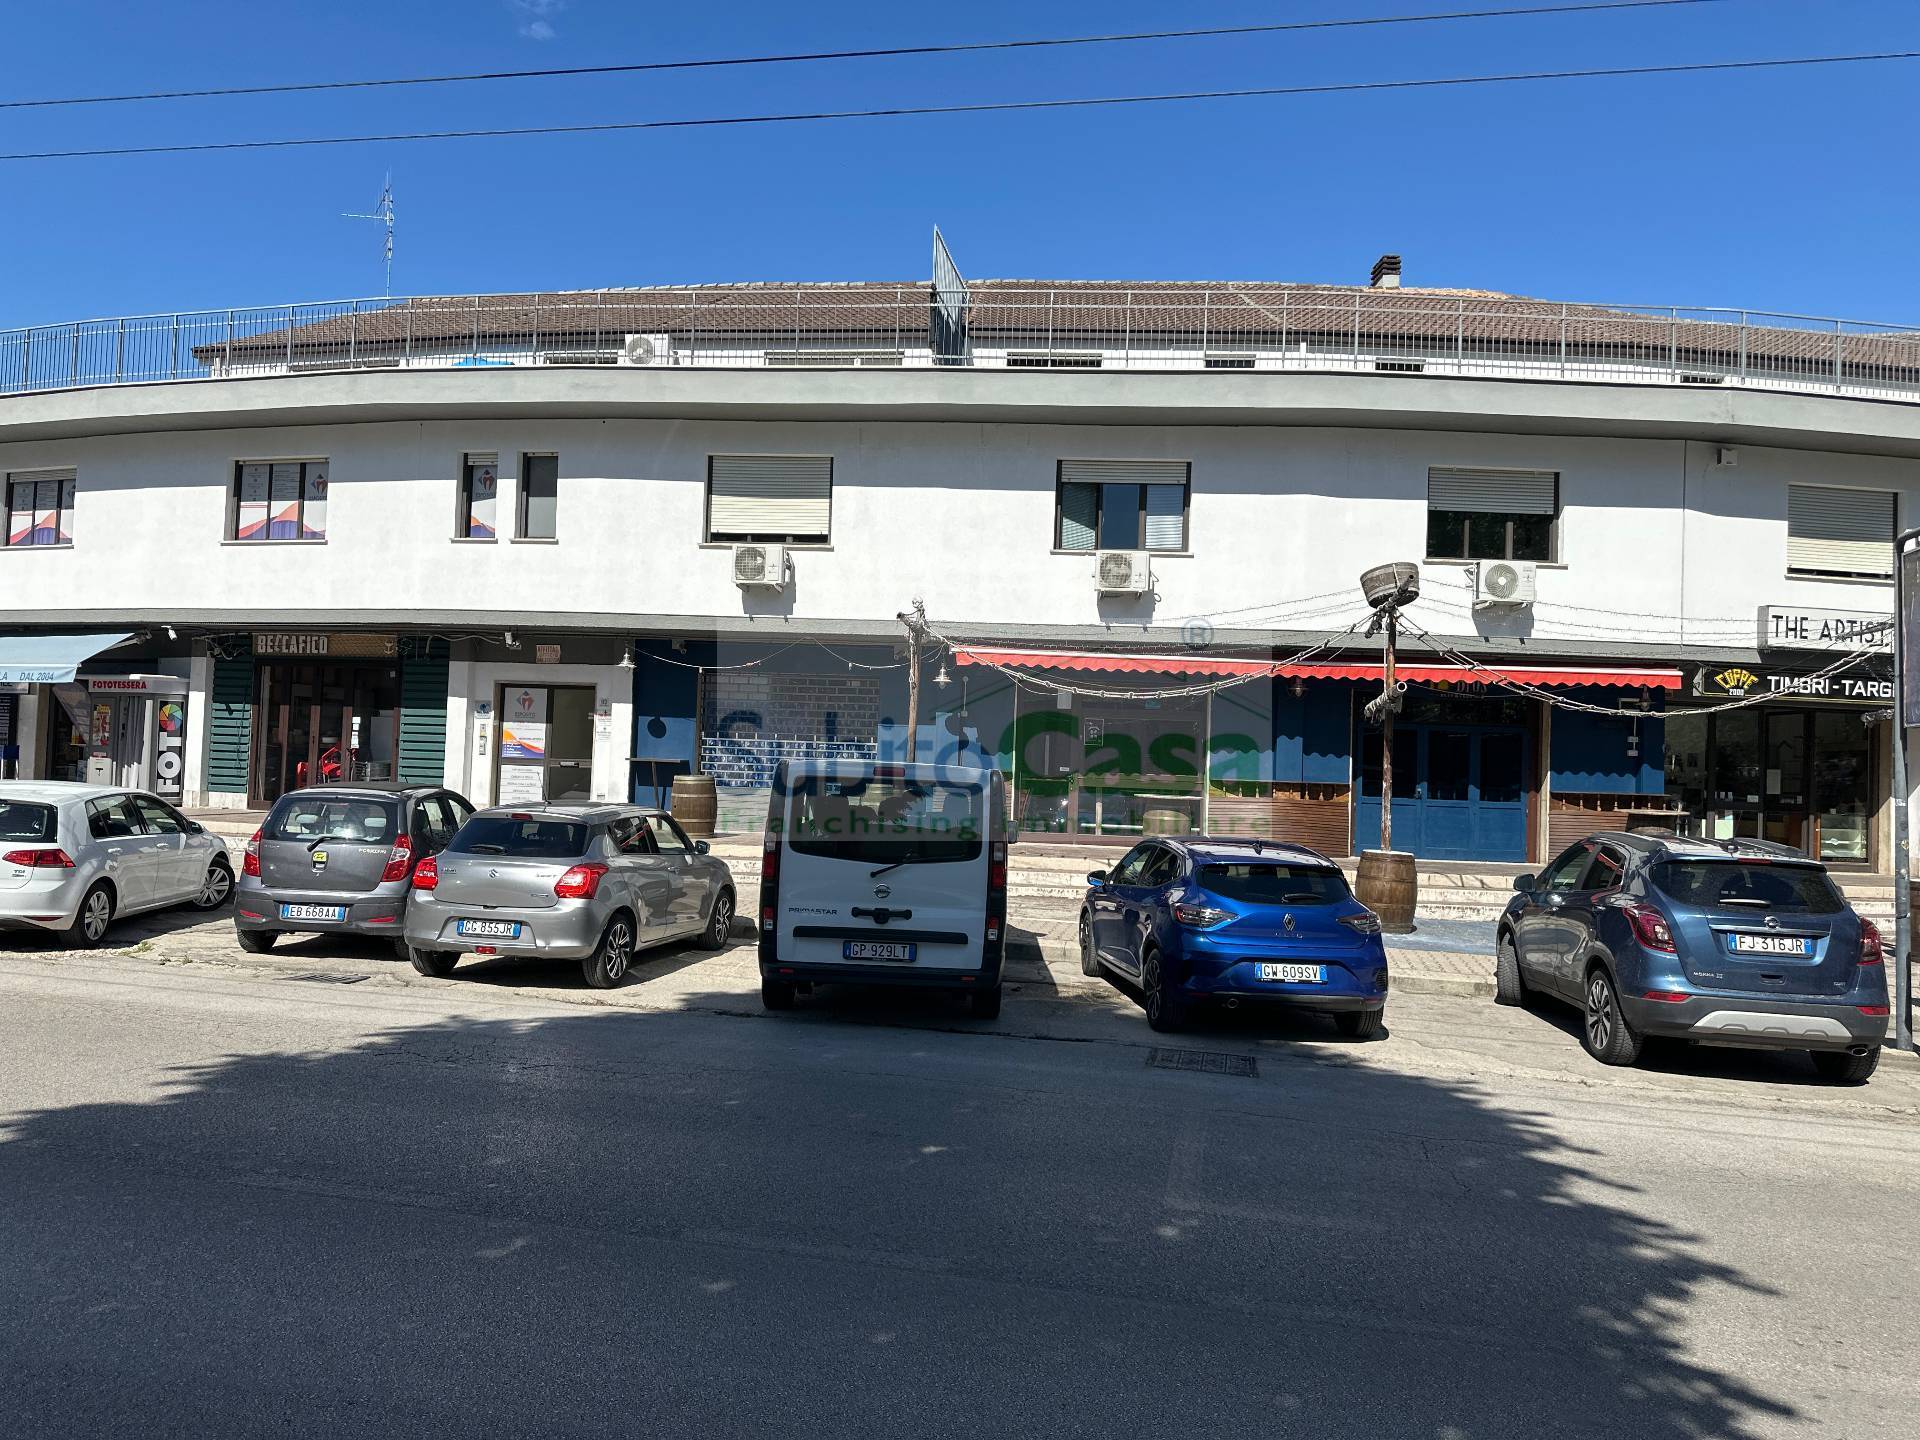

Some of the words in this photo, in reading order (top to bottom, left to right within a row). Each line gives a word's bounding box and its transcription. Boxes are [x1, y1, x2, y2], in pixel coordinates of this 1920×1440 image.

[1771, 614, 1809, 640] THE
[256, 634, 329, 654] BECCAFICO
[19, 672, 35, 681] DAL
[36, 672, 55, 681] 2004
[92, 680, 147, 690] FOTOTESSERA
[289, 906, 303, 917] EB
[305, 907, 337, 918] 668AA
[788, 907, 838, 915] PRIMASTAR
[480, 922, 513, 934] 855JR
[1739, 936, 1755, 949] FJ
[1761, 937, 1803, 952] 316JR
[852, 944, 867, 956] GP
[871, 945, 908, 958] 929LT
[1263, 964, 1278, 978] GW
[1282, 965, 1318, 979] 609SV
